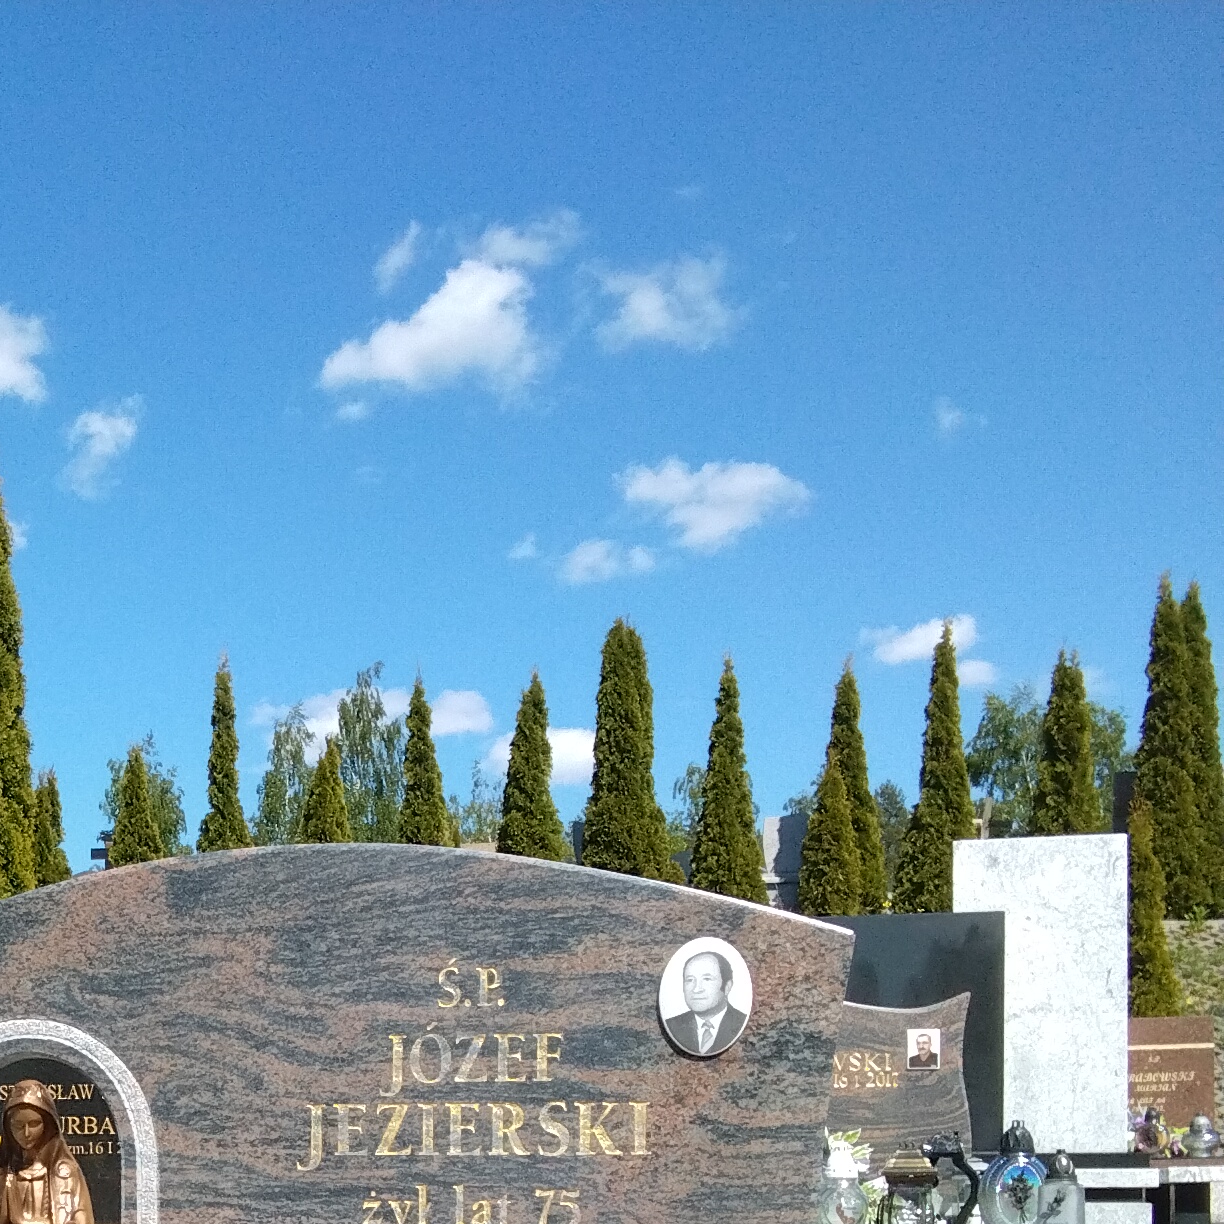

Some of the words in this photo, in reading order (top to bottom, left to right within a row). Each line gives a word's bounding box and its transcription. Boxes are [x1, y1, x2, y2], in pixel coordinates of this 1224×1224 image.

[437, 957, 505, 1008] Ś.P.
[380, 1024, 564, 1097] JÓZEF
[295, 1100, 653, 1171] JEZIERSKI
